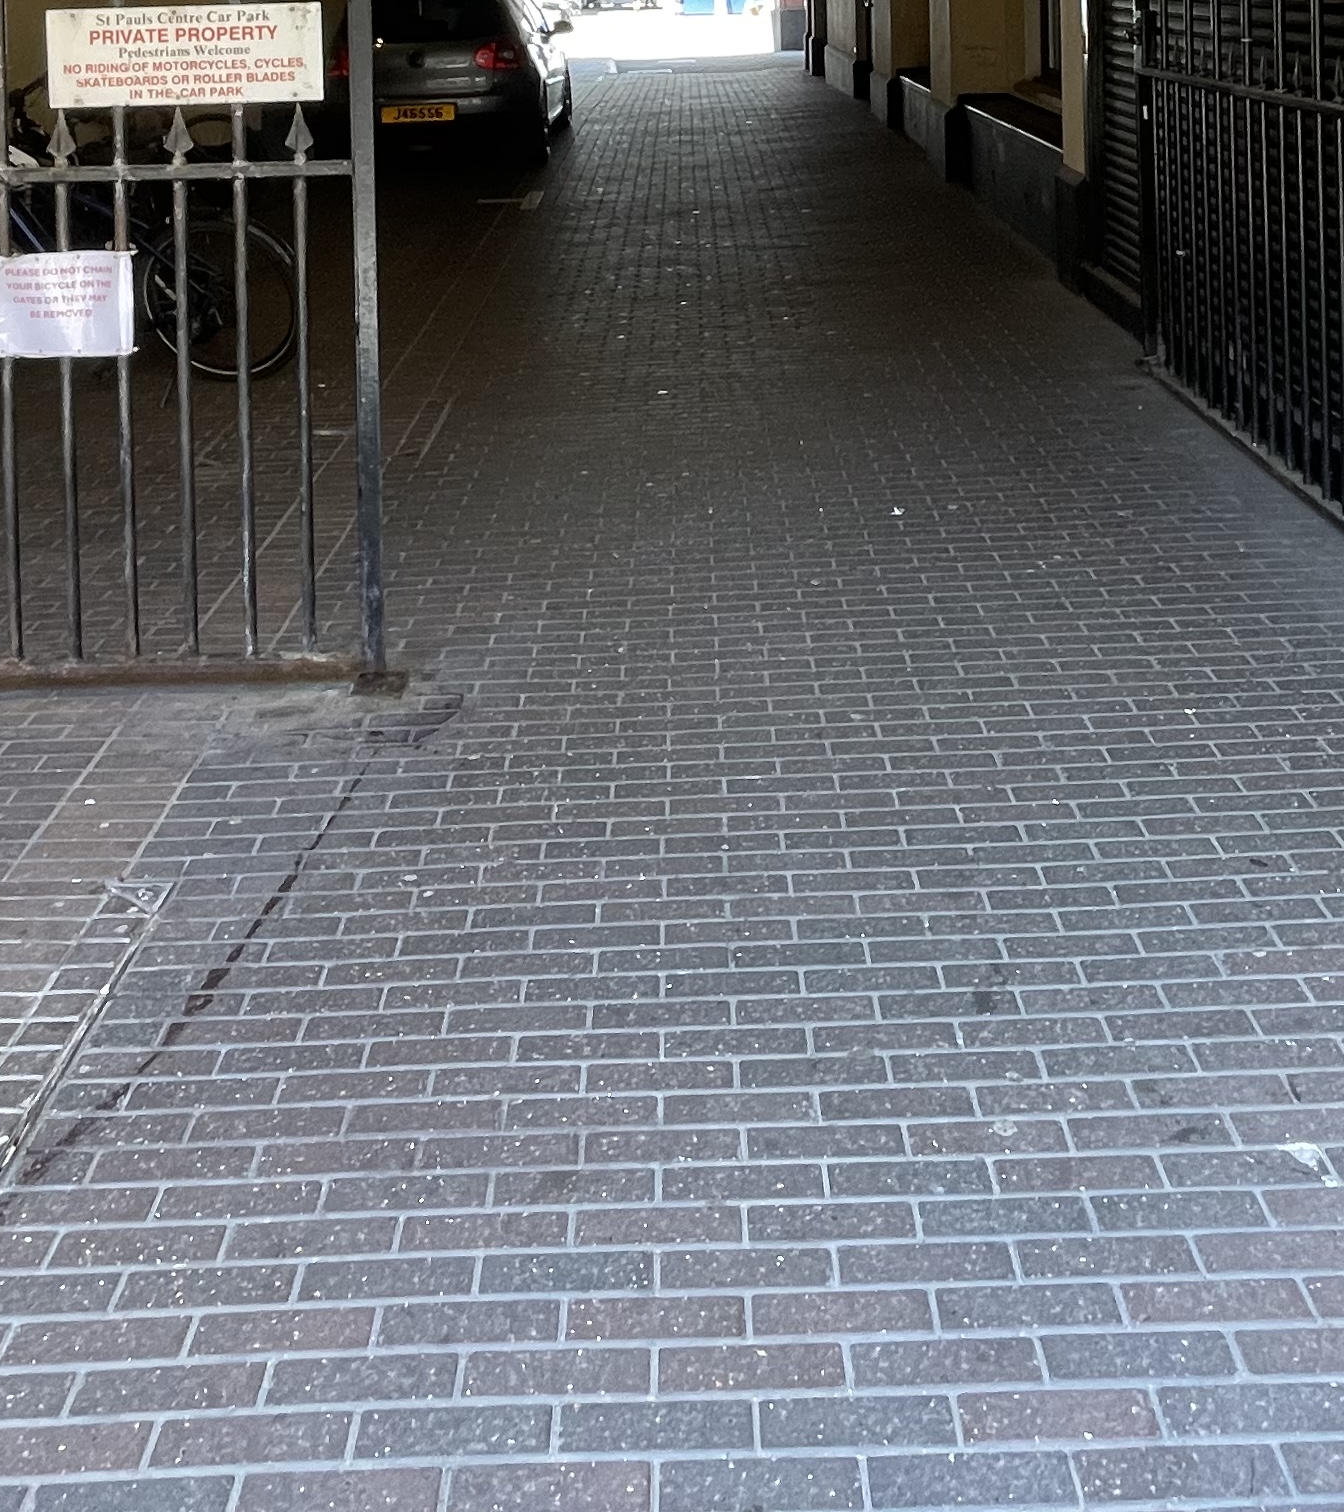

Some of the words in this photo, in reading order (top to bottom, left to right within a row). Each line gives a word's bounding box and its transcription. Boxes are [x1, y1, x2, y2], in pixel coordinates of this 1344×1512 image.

[96, 14, 113, 26] St
[116, 12, 153, 25] Pauls
[157, 11, 202, 23] Centre
[207, 10, 232, 22] Car
[238, 9, 270, 22] Park
[89, 28, 169, 45] PRIVATE
[175, 25, 278, 42] PROPERTY
[118, 46, 190, 59] Pedestrians
[193, 45, 251, 56] Welcome
[63, 64, 81, 74] NO
[85, 62, 129, 74] RIDING
[132, 62, 149, 72] OF
[152, 59, 251, 72] MOTORCYCLES,
[76, 75, 168, 87] SKATEBOARDS
[172, 74, 189, 85] OR
[193, 73, 242, 84] ROLLER
[246, 71, 295, 83] BLADES
[130, 89, 143, 100] IN
[148, 88, 173, 99] THE
[180, 87, 206, 98] CAR
[210, 86, 244, 97] PARK
[5, 268, 41, 276] PLEASE
[43, 267, 57, 275] DO
[60, 267, 80, 275] NOT
[83, 266, 112, 274] CHAIN
[35, 281, 76, 290] BICYCLE
[96, 280, 111, 288] THE
[44, 296, 59, 304] OR
[62, 295, 87, 303] THEY
[30, 311, 41, 319] BE
[44, 310, 92, 318] REMOVED
